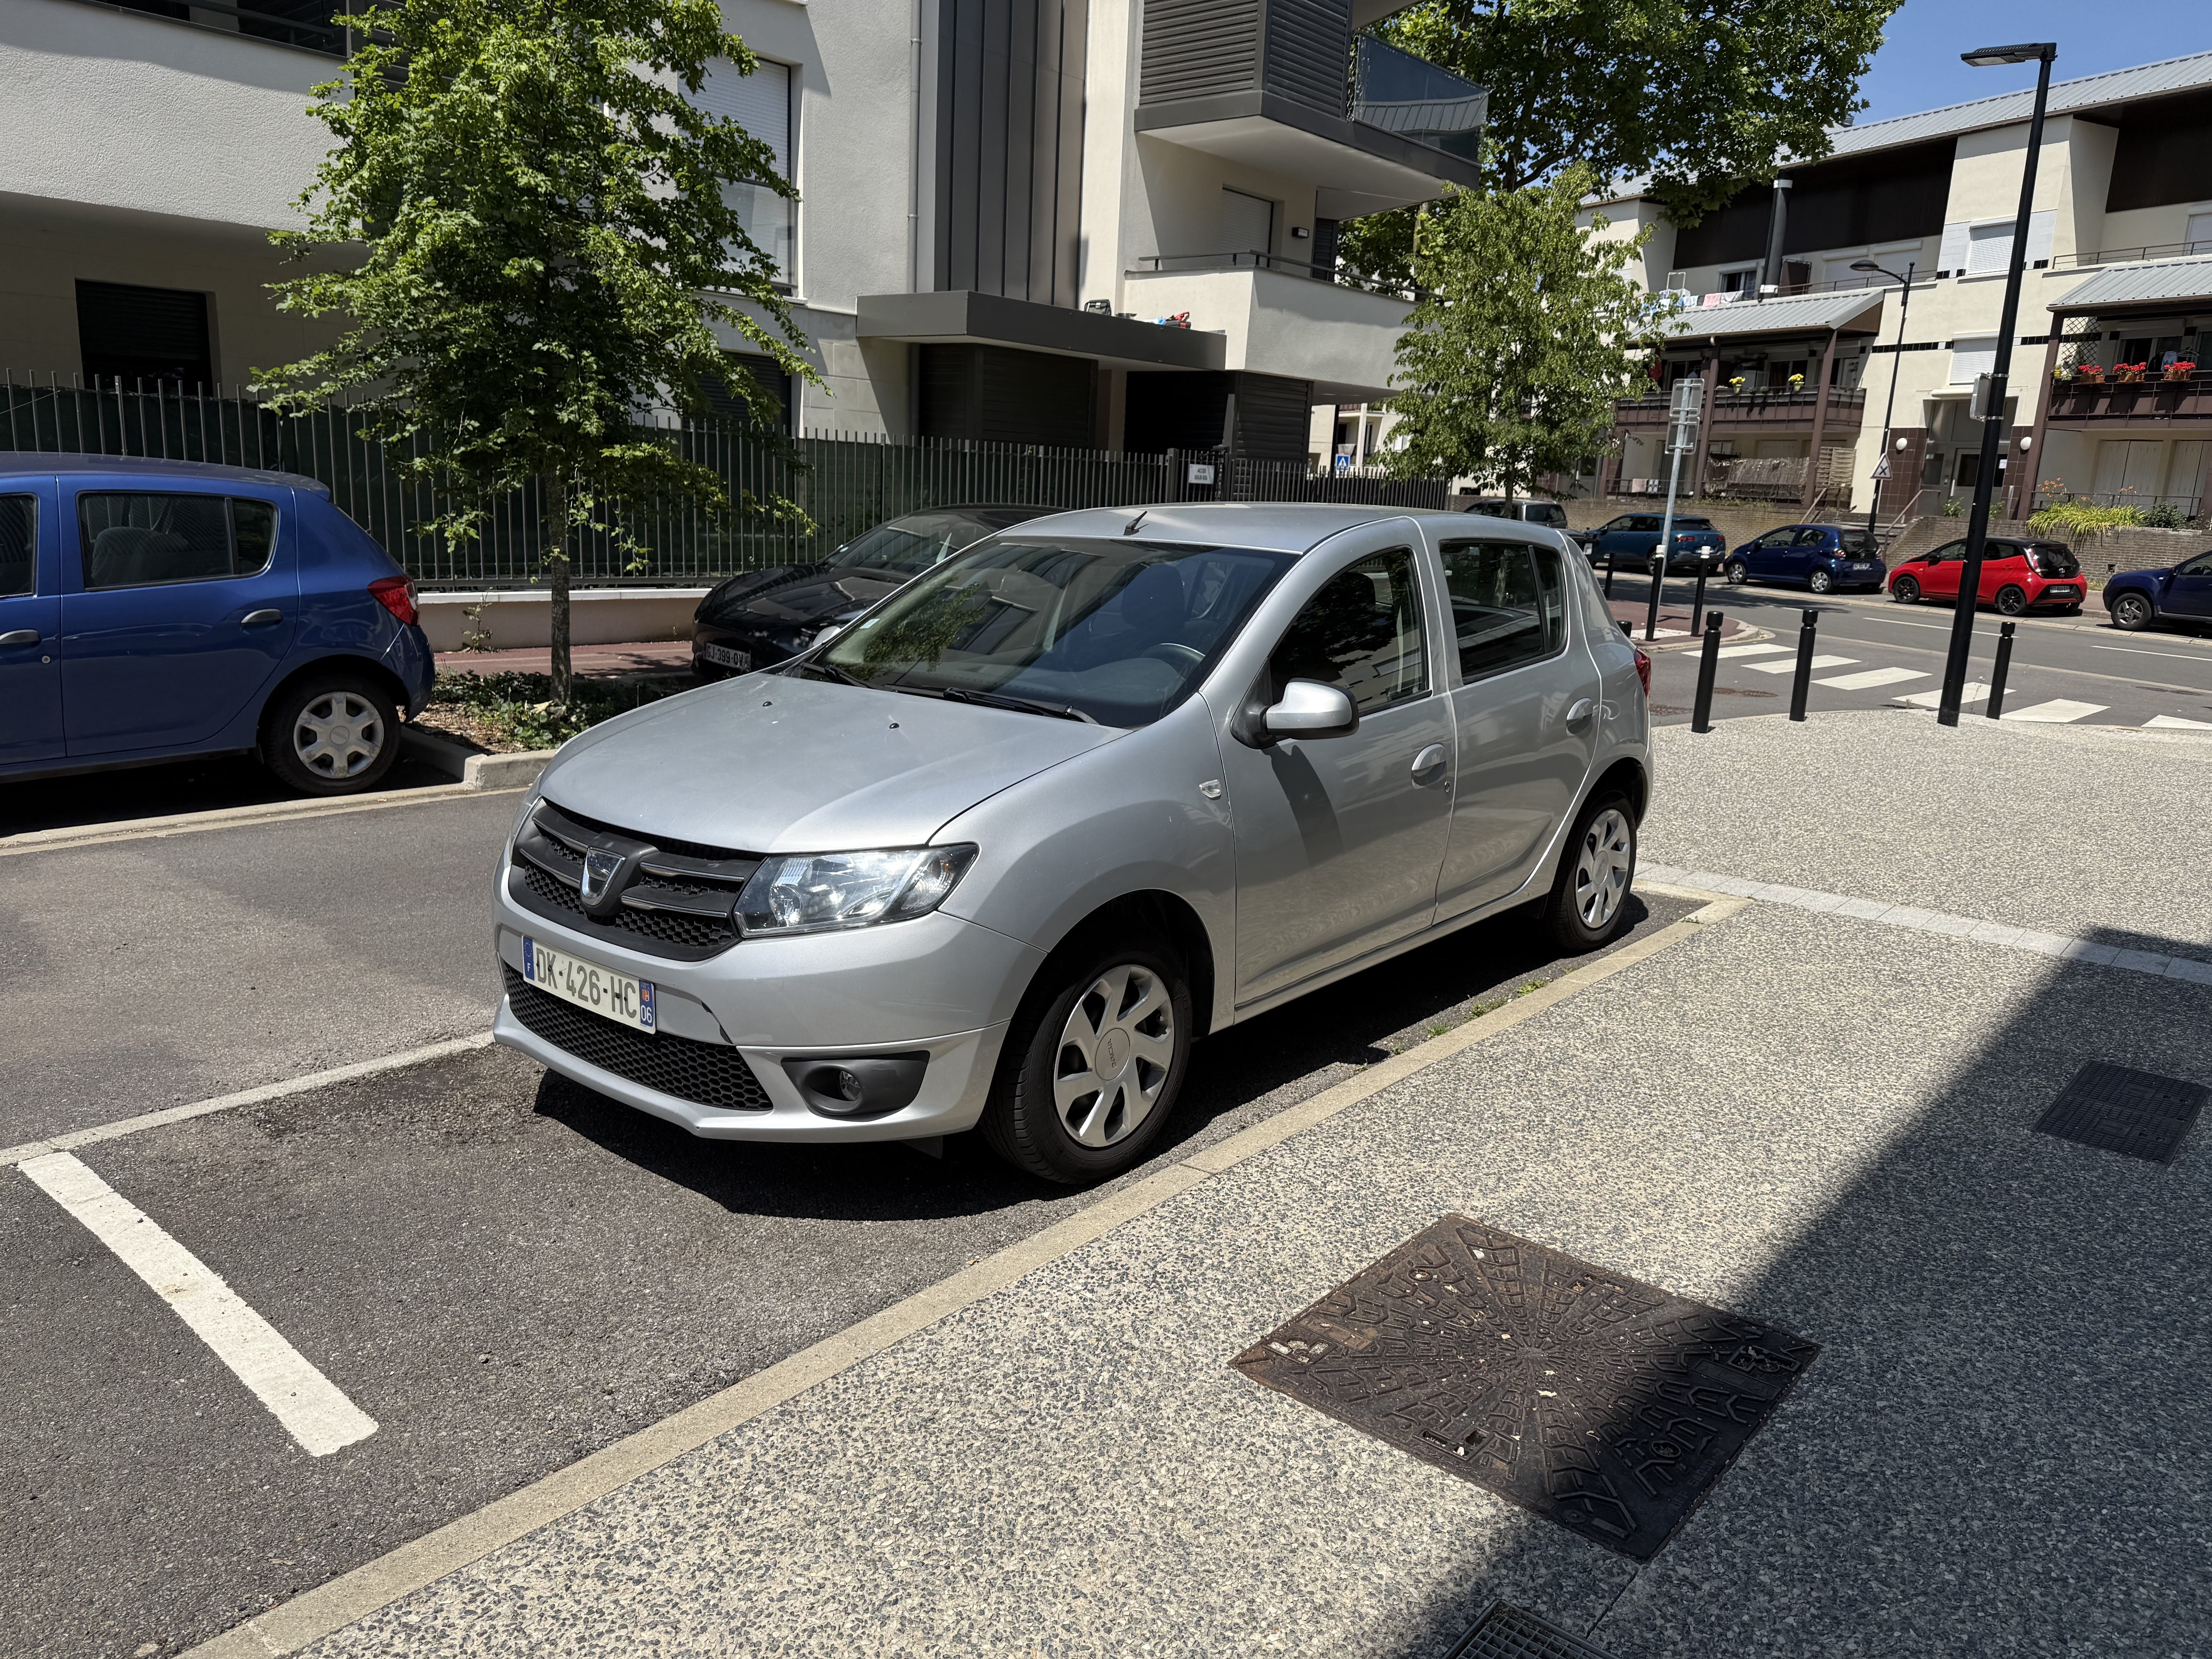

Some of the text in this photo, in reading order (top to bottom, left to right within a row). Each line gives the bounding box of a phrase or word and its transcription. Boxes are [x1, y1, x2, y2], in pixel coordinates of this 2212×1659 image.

[527, 962, 531, 972] F
[536, 947, 637, 1018] DK-426-HC
[641, 1005, 652, 1023] 06
[1108, 1038, 1117, 1069] DACIA
